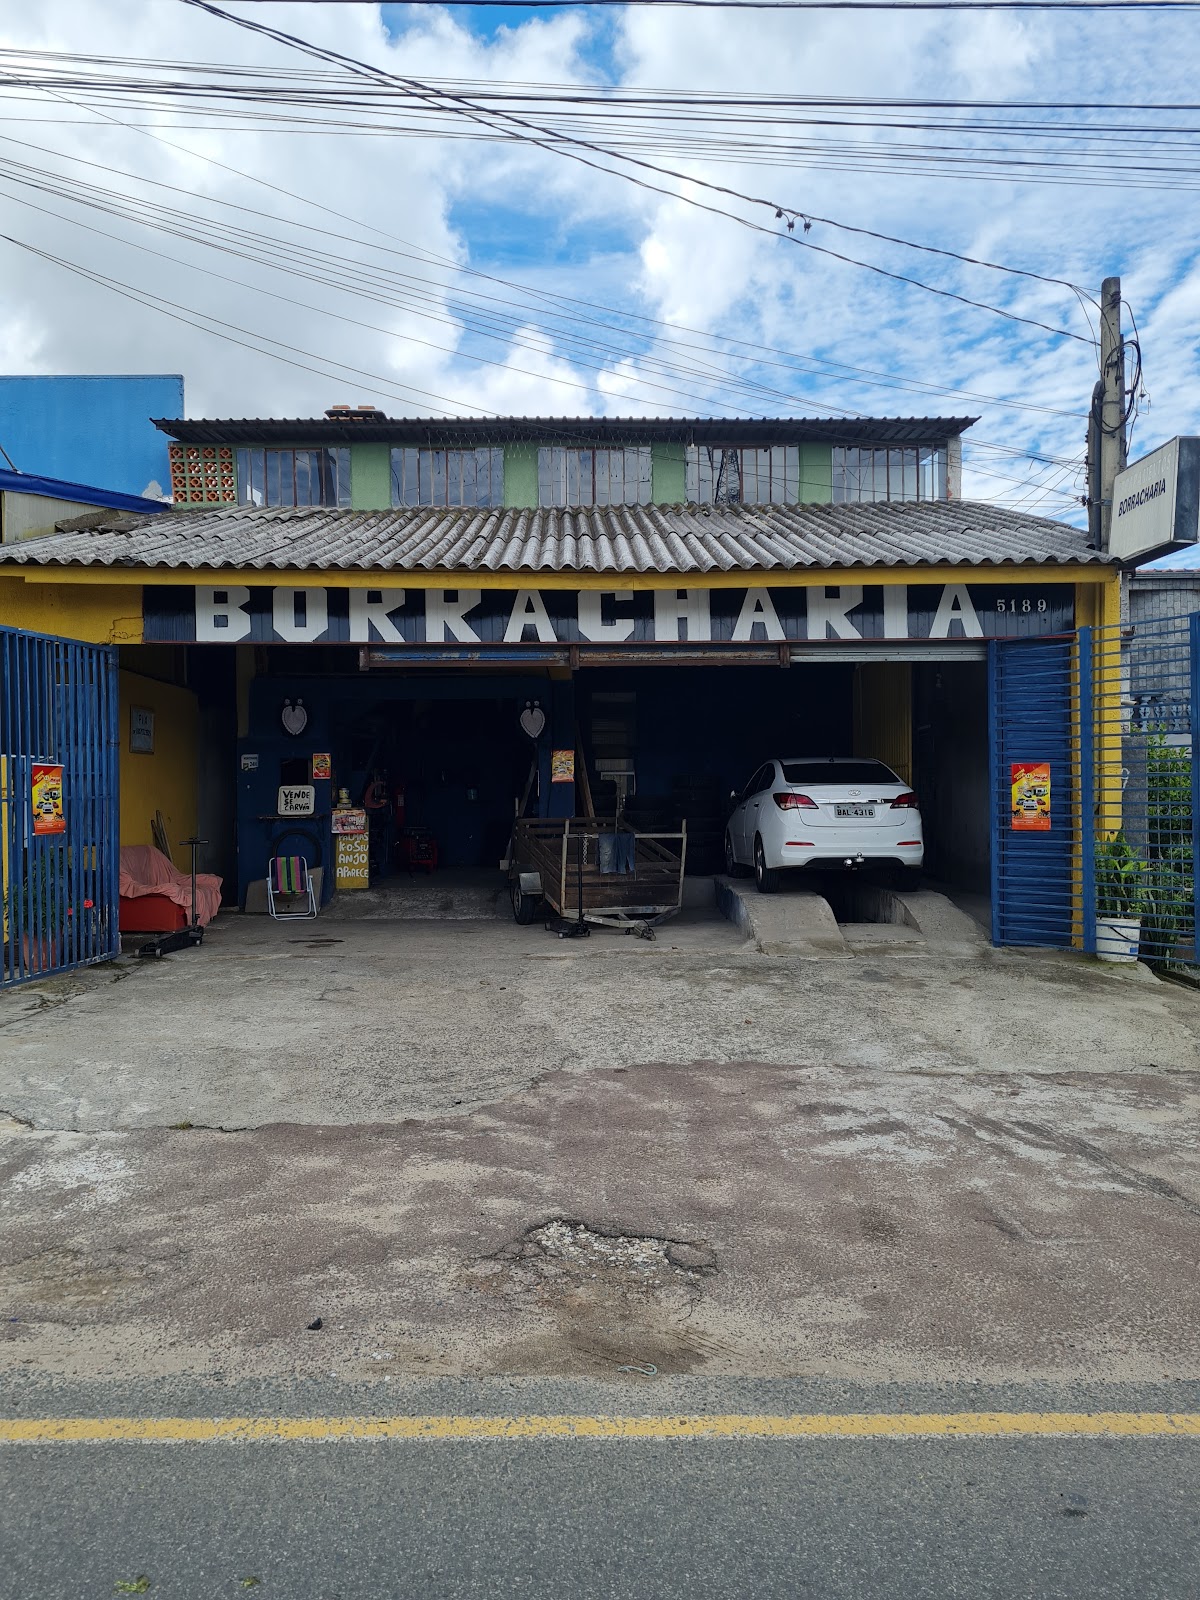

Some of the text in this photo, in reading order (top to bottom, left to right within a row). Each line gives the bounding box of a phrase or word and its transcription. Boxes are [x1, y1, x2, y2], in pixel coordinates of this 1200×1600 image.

[1118, 478, 1166, 517] BORRACHARIA
[996, 599, 1047, 613] 5189
[195, 584, 985, 643] BORRACHARIA
[282, 790, 310, 799] VENDE
[338, 831, 369, 841] PALMAS
[338, 853, 367, 865] ANJO
[336, 866, 369, 878] APARECE
